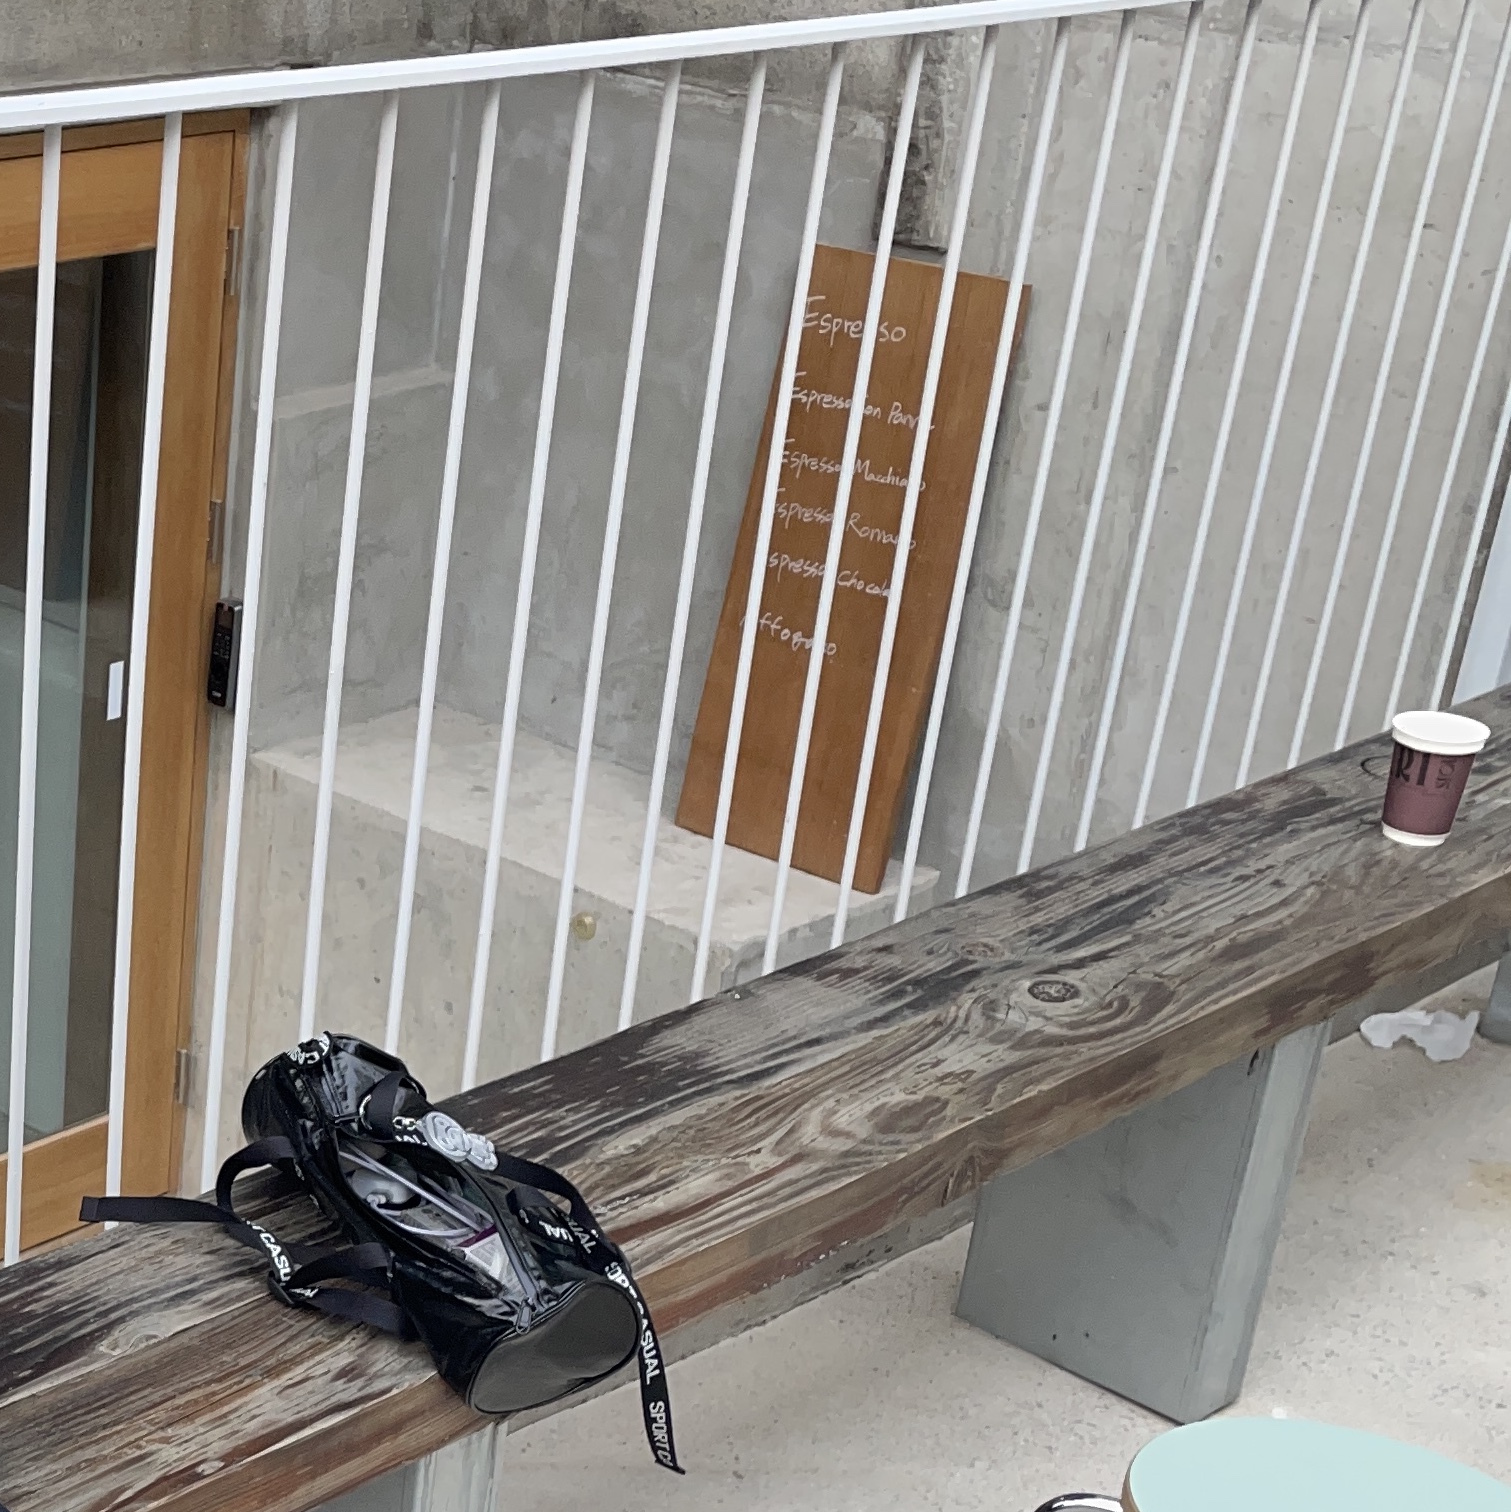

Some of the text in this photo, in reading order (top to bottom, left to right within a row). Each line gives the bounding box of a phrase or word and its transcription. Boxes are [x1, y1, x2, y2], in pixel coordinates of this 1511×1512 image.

[802, 295, 906, 348] Espreso
[775, 488, 835, 529] spresso
[768, 552, 827, 583] spresso
[649, 1400, 670, 1450] SPORT
